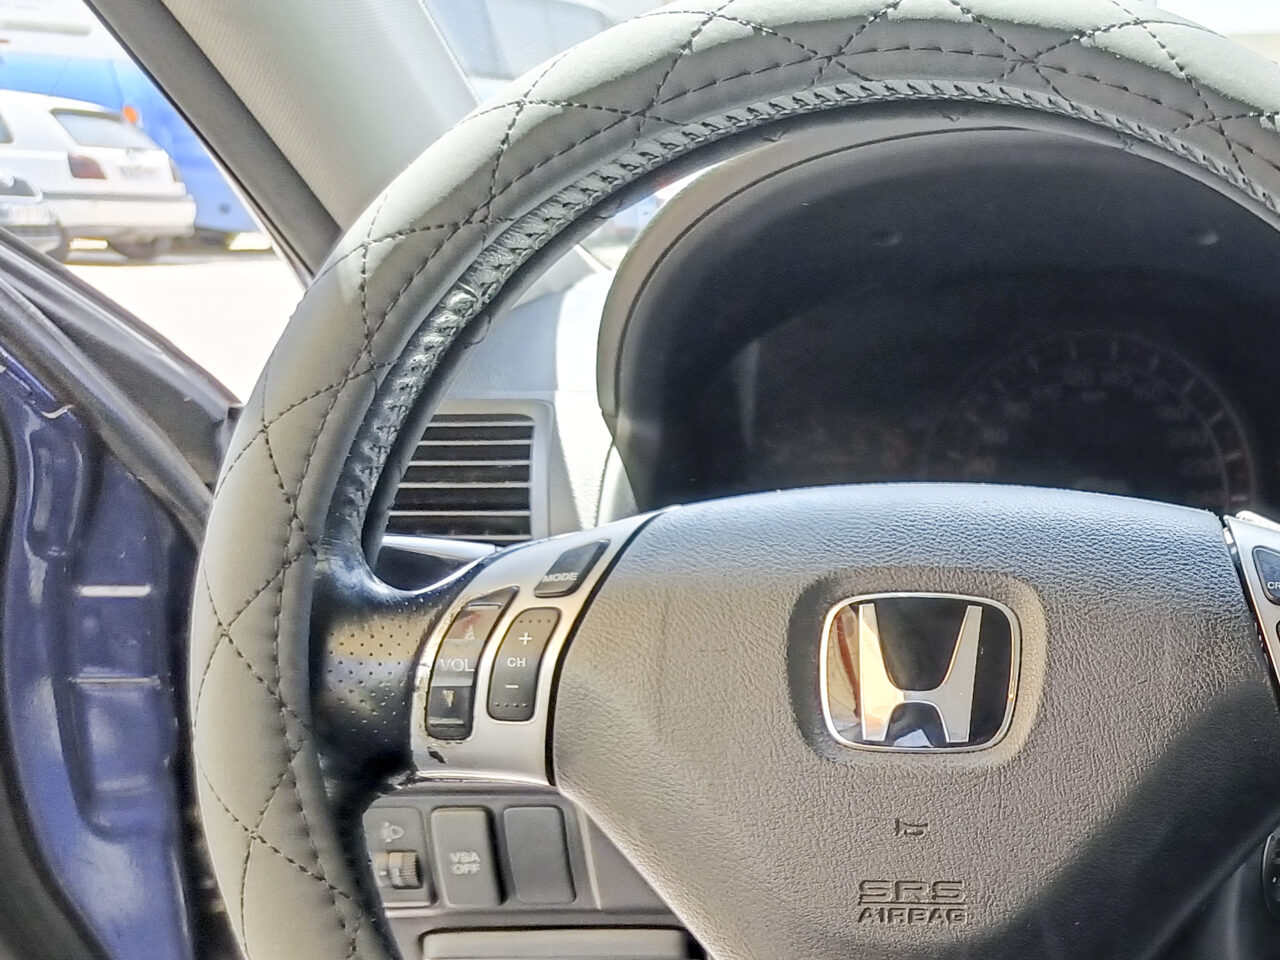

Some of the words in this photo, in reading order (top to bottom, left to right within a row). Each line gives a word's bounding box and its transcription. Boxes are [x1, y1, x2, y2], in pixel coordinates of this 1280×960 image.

[542, 572, 579, 582] MODE
[440, 658, 475, 672] VOL
[507, 657, 526, 667] CH
[450, 852, 480, 863] VSA
[453, 863, 480, 875] OFF
[859, 880, 965, 901] SRS
[858, 907, 967, 923] AIRBAG
